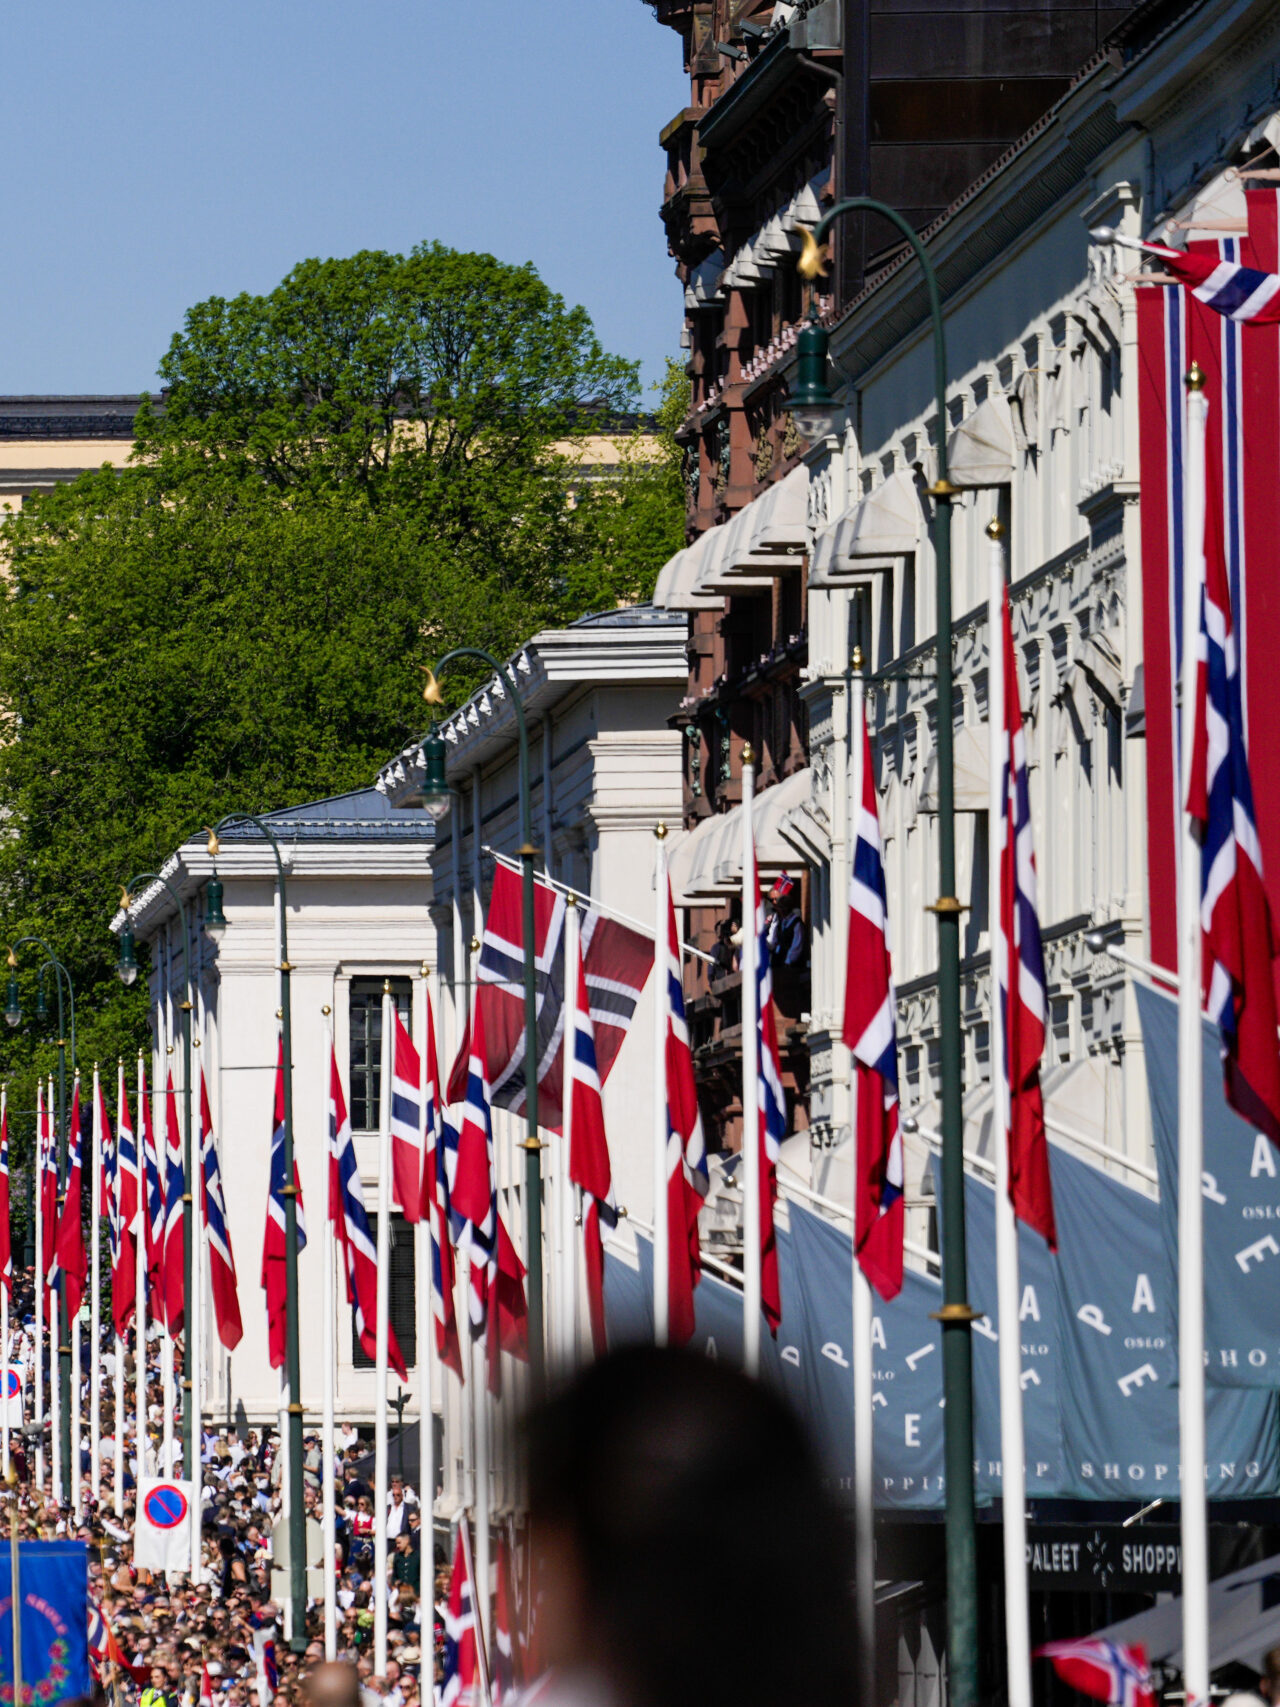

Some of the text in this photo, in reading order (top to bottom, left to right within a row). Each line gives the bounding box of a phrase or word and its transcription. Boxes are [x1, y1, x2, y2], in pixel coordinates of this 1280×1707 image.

[1124, 1337, 1165, 1349] OSLO
[1020, 1344, 1049, 1355] SLO
[1024, 1543, 1081, 1572] PALEET
